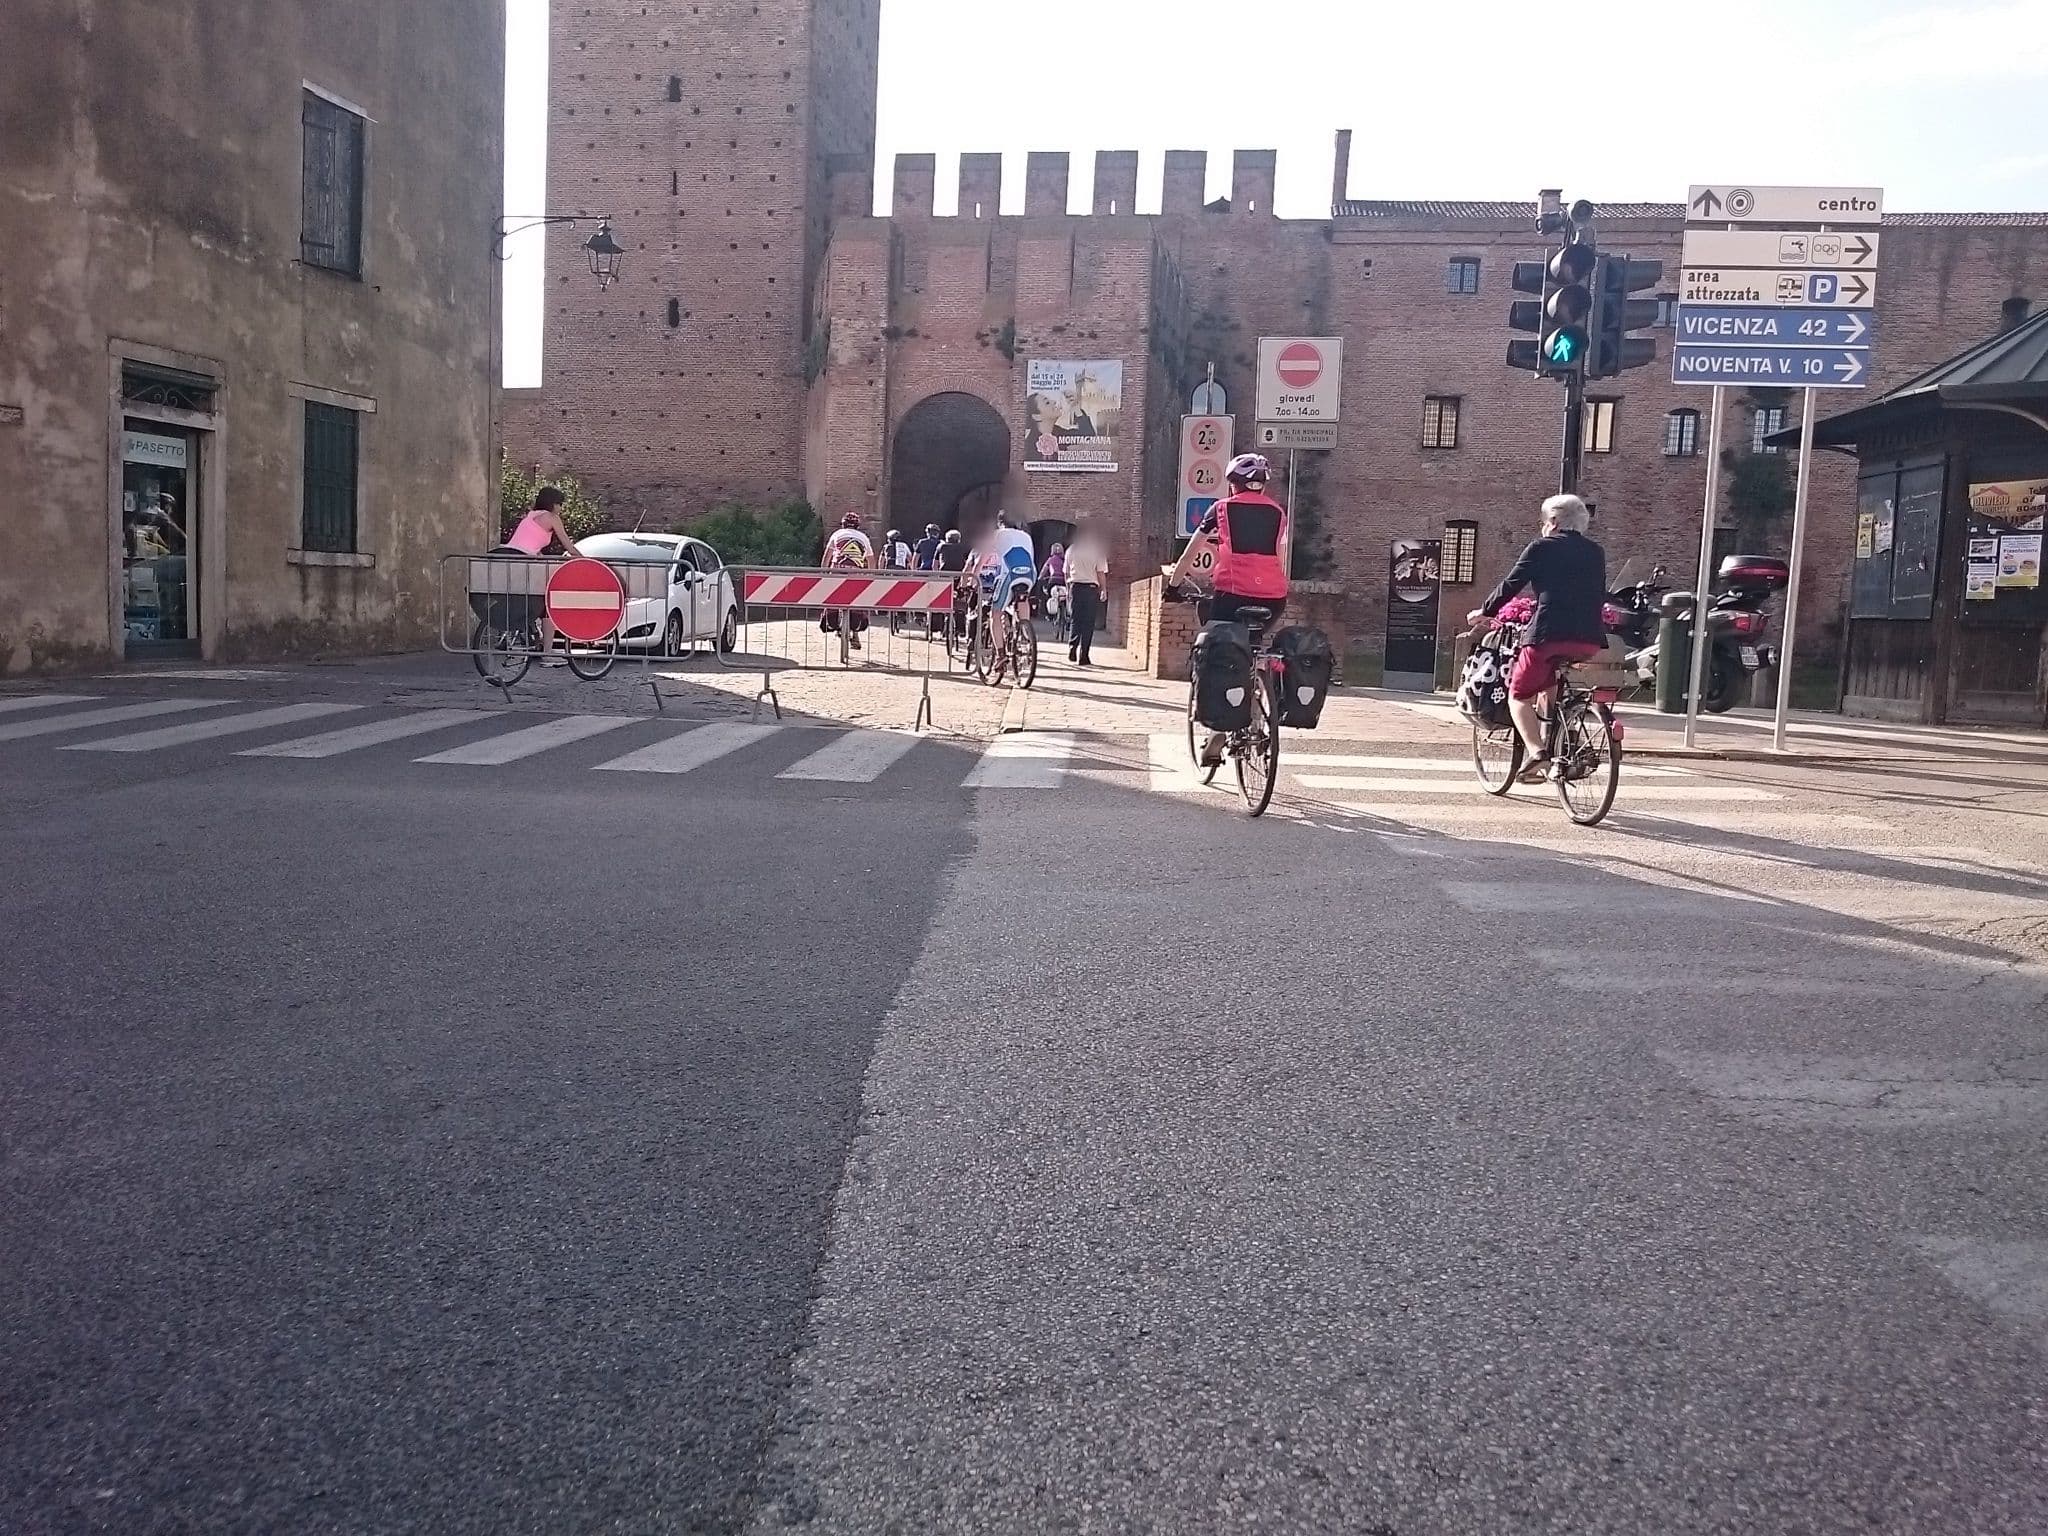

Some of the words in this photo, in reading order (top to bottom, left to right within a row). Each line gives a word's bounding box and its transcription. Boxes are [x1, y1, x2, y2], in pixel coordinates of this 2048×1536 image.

[1818, 196, 1877, 212] centro
[1687, 272, 1719, 283] area
[1686, 286, 1760, 301] attrezzata
[1684, 316, 1778, 336] VICENZA
[1798, 319, 1827, 337] 42
[1679, 356, 1773, 374] NOVENTA
[1779, 358, 1792, 374] V.
[1803, 358, 1824, 375] 10
[136, 440, 185, 456] PASETTO
[1192, 552, 1212, 569] 30
